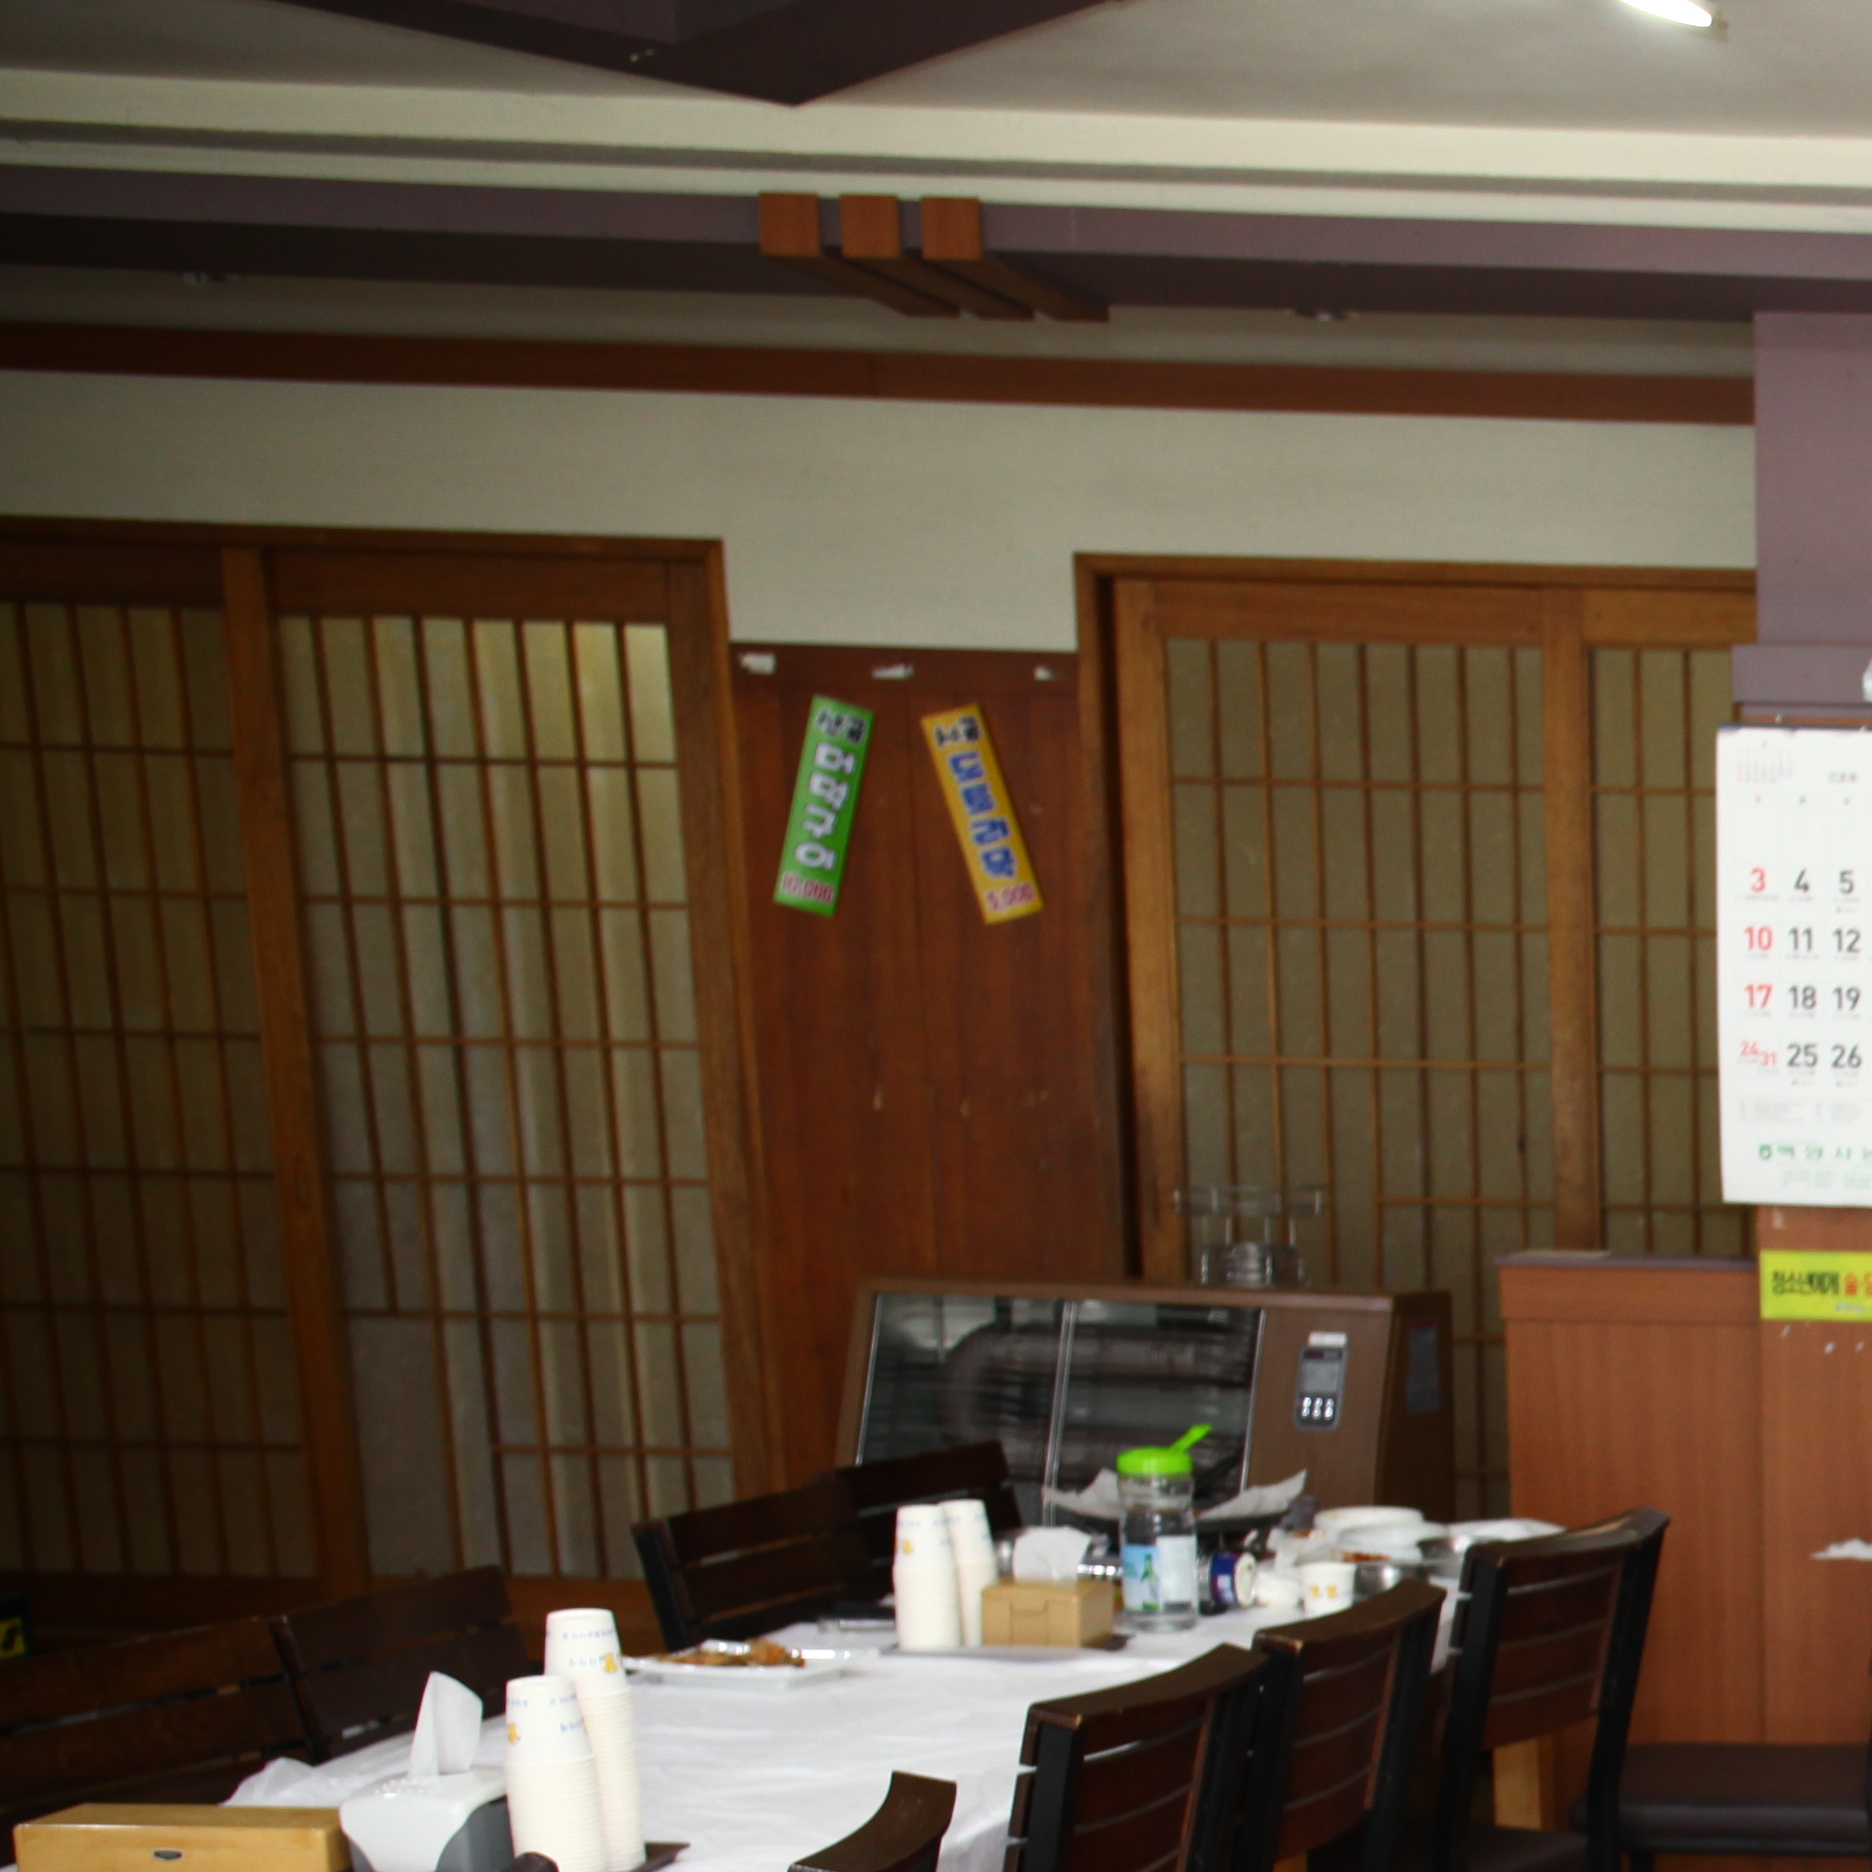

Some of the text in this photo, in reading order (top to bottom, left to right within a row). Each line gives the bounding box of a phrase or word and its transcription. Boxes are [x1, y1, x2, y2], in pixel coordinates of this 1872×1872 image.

[795, 742, 856, 870] 더덕구이
[1752, 868, 1766, 892] 3
[1794, 869, 1810, 893] 4
[1840, 870, 1854, 894] 5
[1745, 926, 1772, 950] 10
[1789, 928, 1812, 951] 11
[1834, 929, 1860, 953] 12
[1745, 984, 1772, 1007] 17
[1789, 985, 1816, 1010] 18
[1834, 987, 1861, 1010] 19
[1788, 1044, 1818, 1067] 25
[1832, 1045, 1862, 1068] 26
